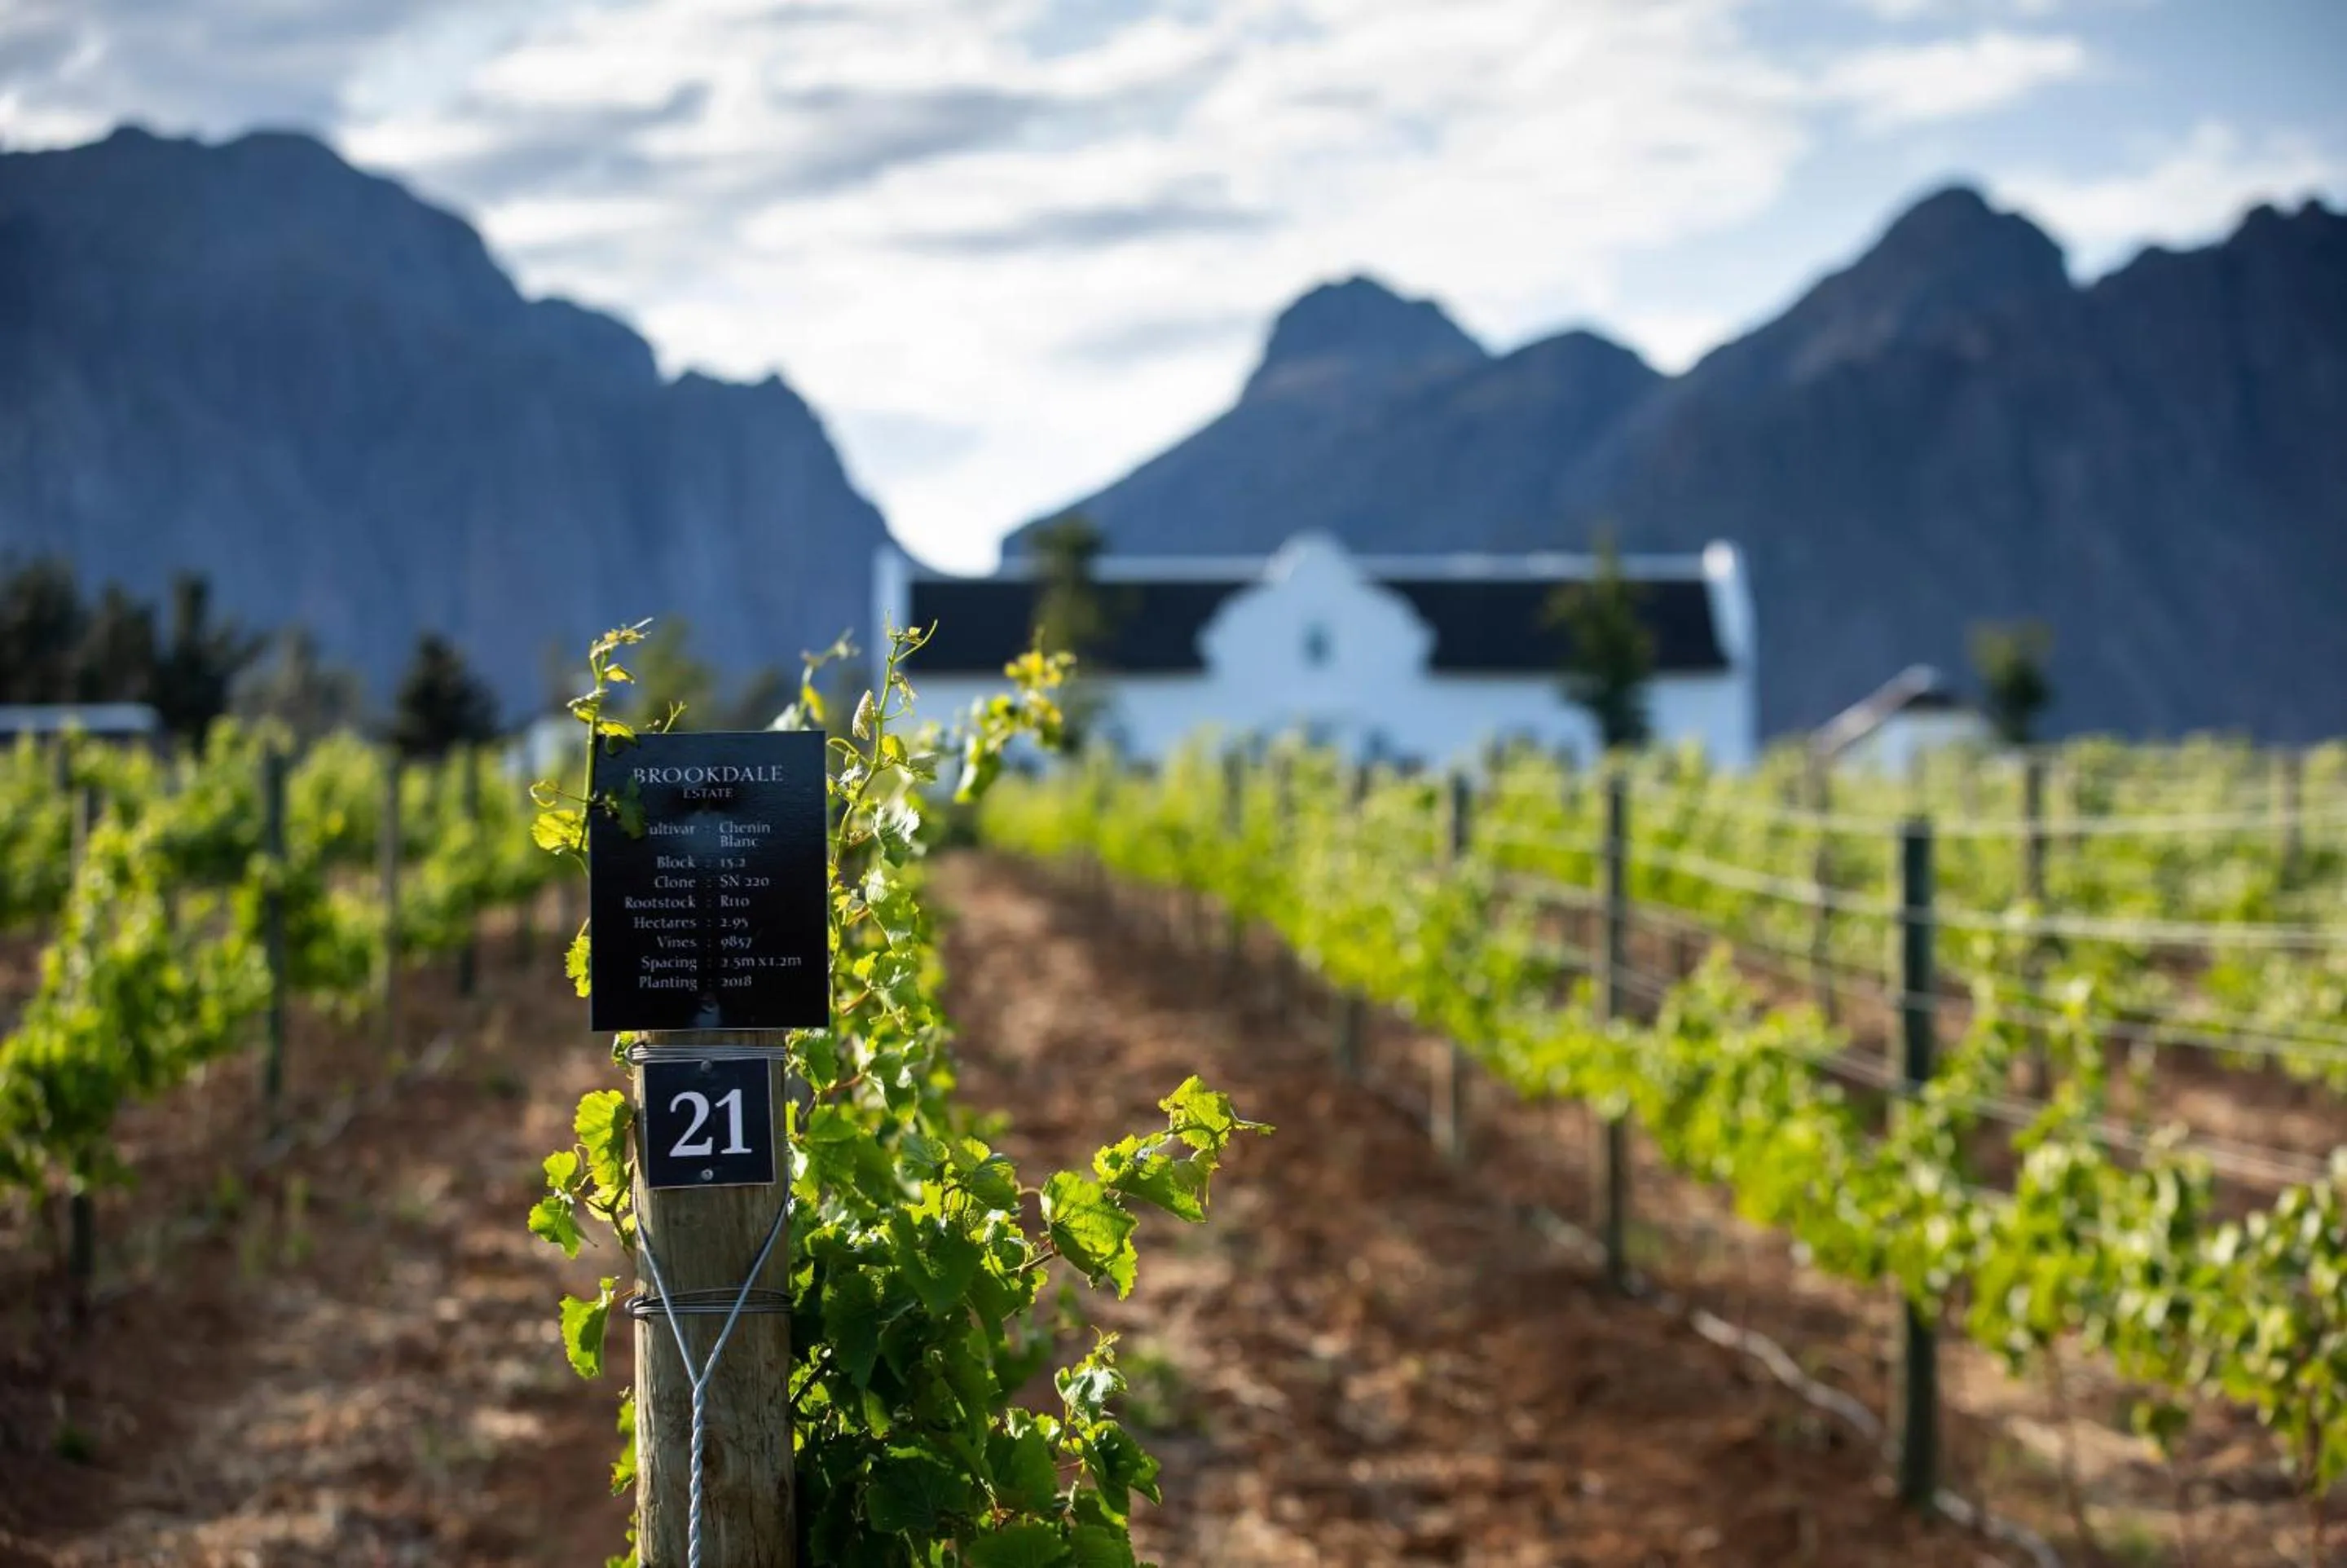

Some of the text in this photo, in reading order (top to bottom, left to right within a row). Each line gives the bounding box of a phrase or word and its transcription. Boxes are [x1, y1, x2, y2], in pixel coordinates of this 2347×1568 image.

[633, 764, 784, 784] BROOKDALE
[683, 787, 733, 799] ESTATE
[644, 821, 695, 835] ultivar
[719, 821, 770, 834] Chenin
[720, 834, 758, 848] Blanc
[656, 854, 696, 869] Block
[654, 874, 696, 888] Clone
[720, 874, 739, 888] SN
[744, 876, 769, 888] 220
[624, 895, 696, 909] Rootstock
[633, 916, 697, 929] Hectares
[656, 935, 697, 949] Vines
[641, 955, 698, 973] Spacing
[639, 975, 698, 992] Planting
[720, 975, 752, 988] 2018
[669, 1088, 753, 1157] 21
